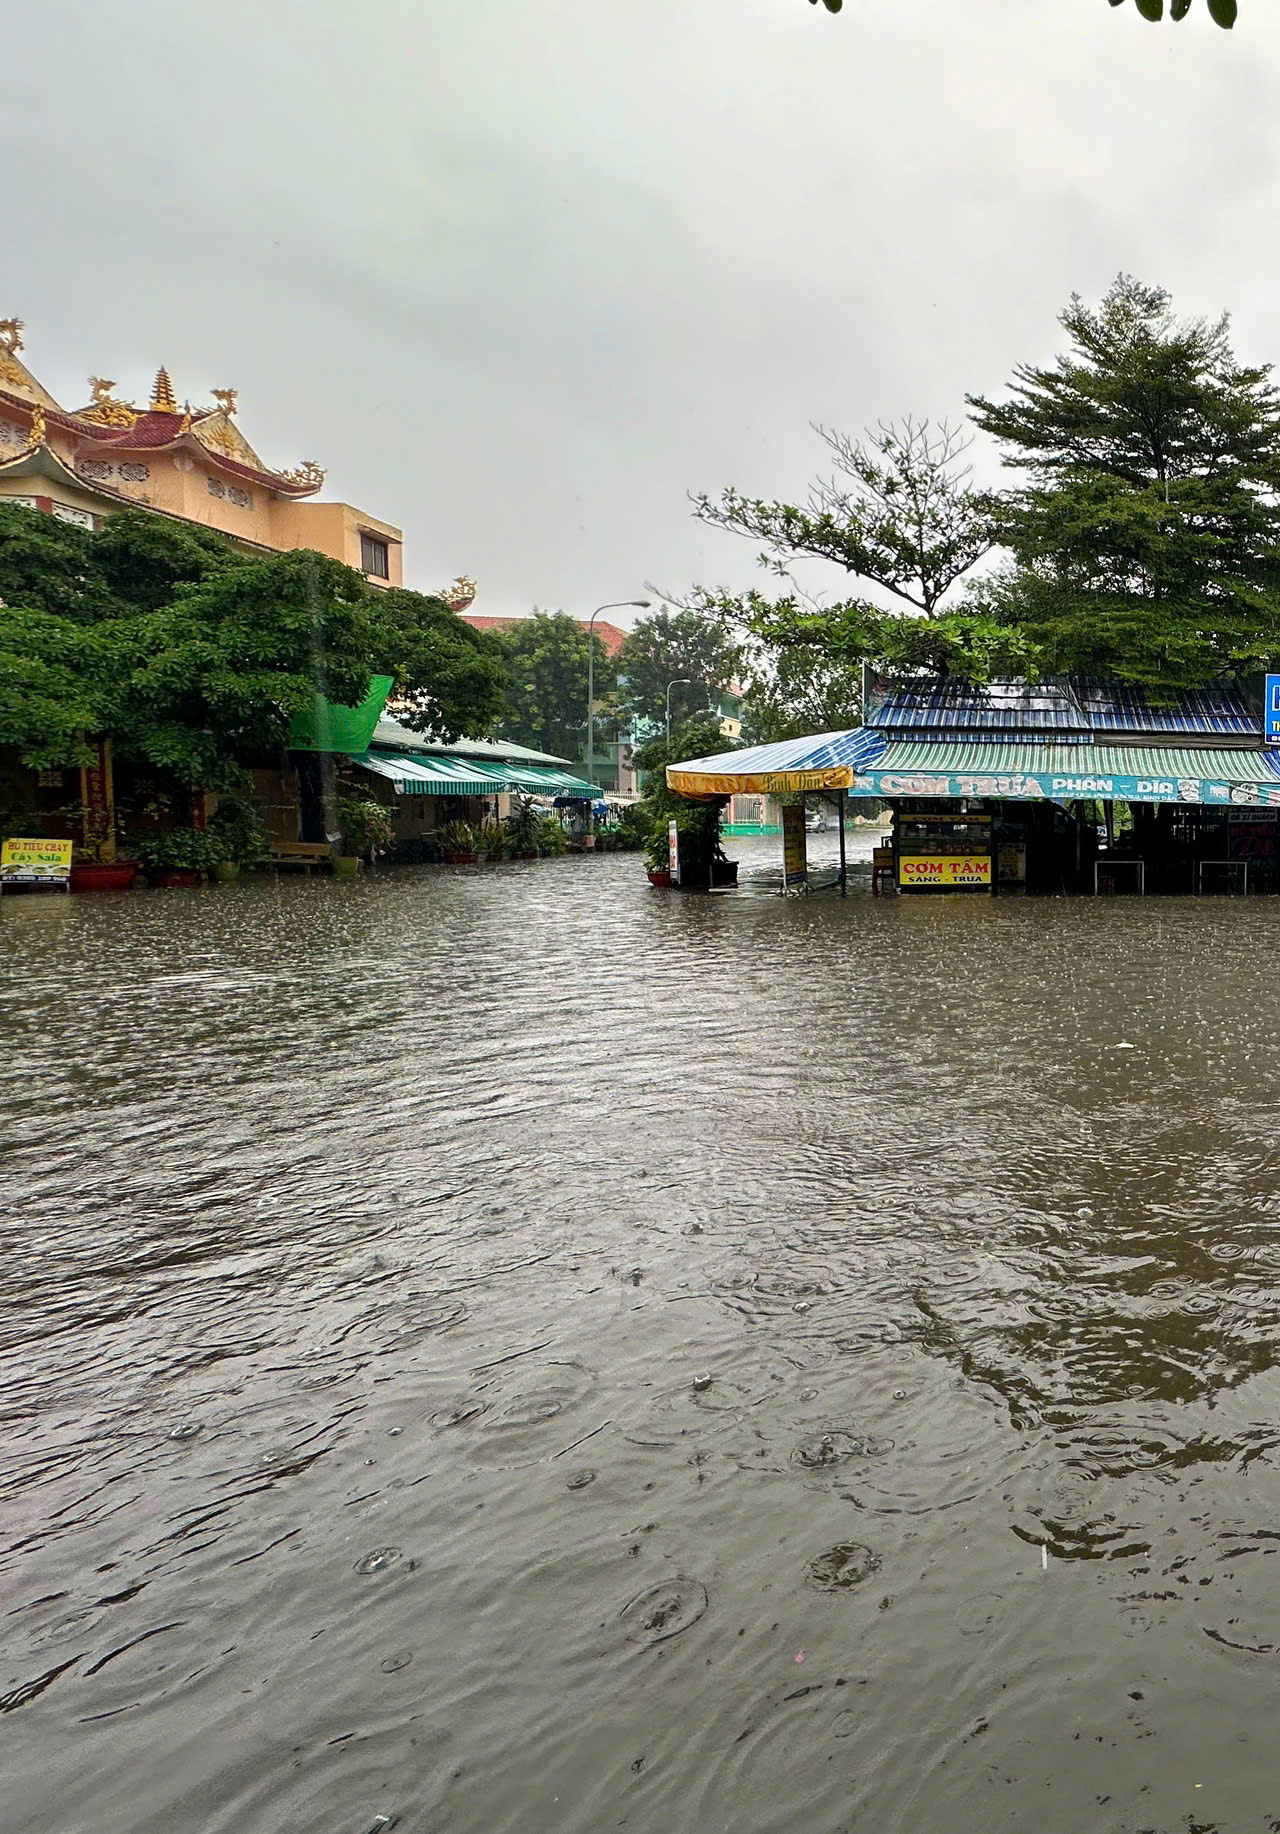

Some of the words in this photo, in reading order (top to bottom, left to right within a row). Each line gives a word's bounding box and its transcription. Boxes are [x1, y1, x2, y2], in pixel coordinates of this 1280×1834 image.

[880, 772, 949, 795] CƠM
[903, 861, 943, 874] CƠM
[949, 858, 989, 874] TẤM
